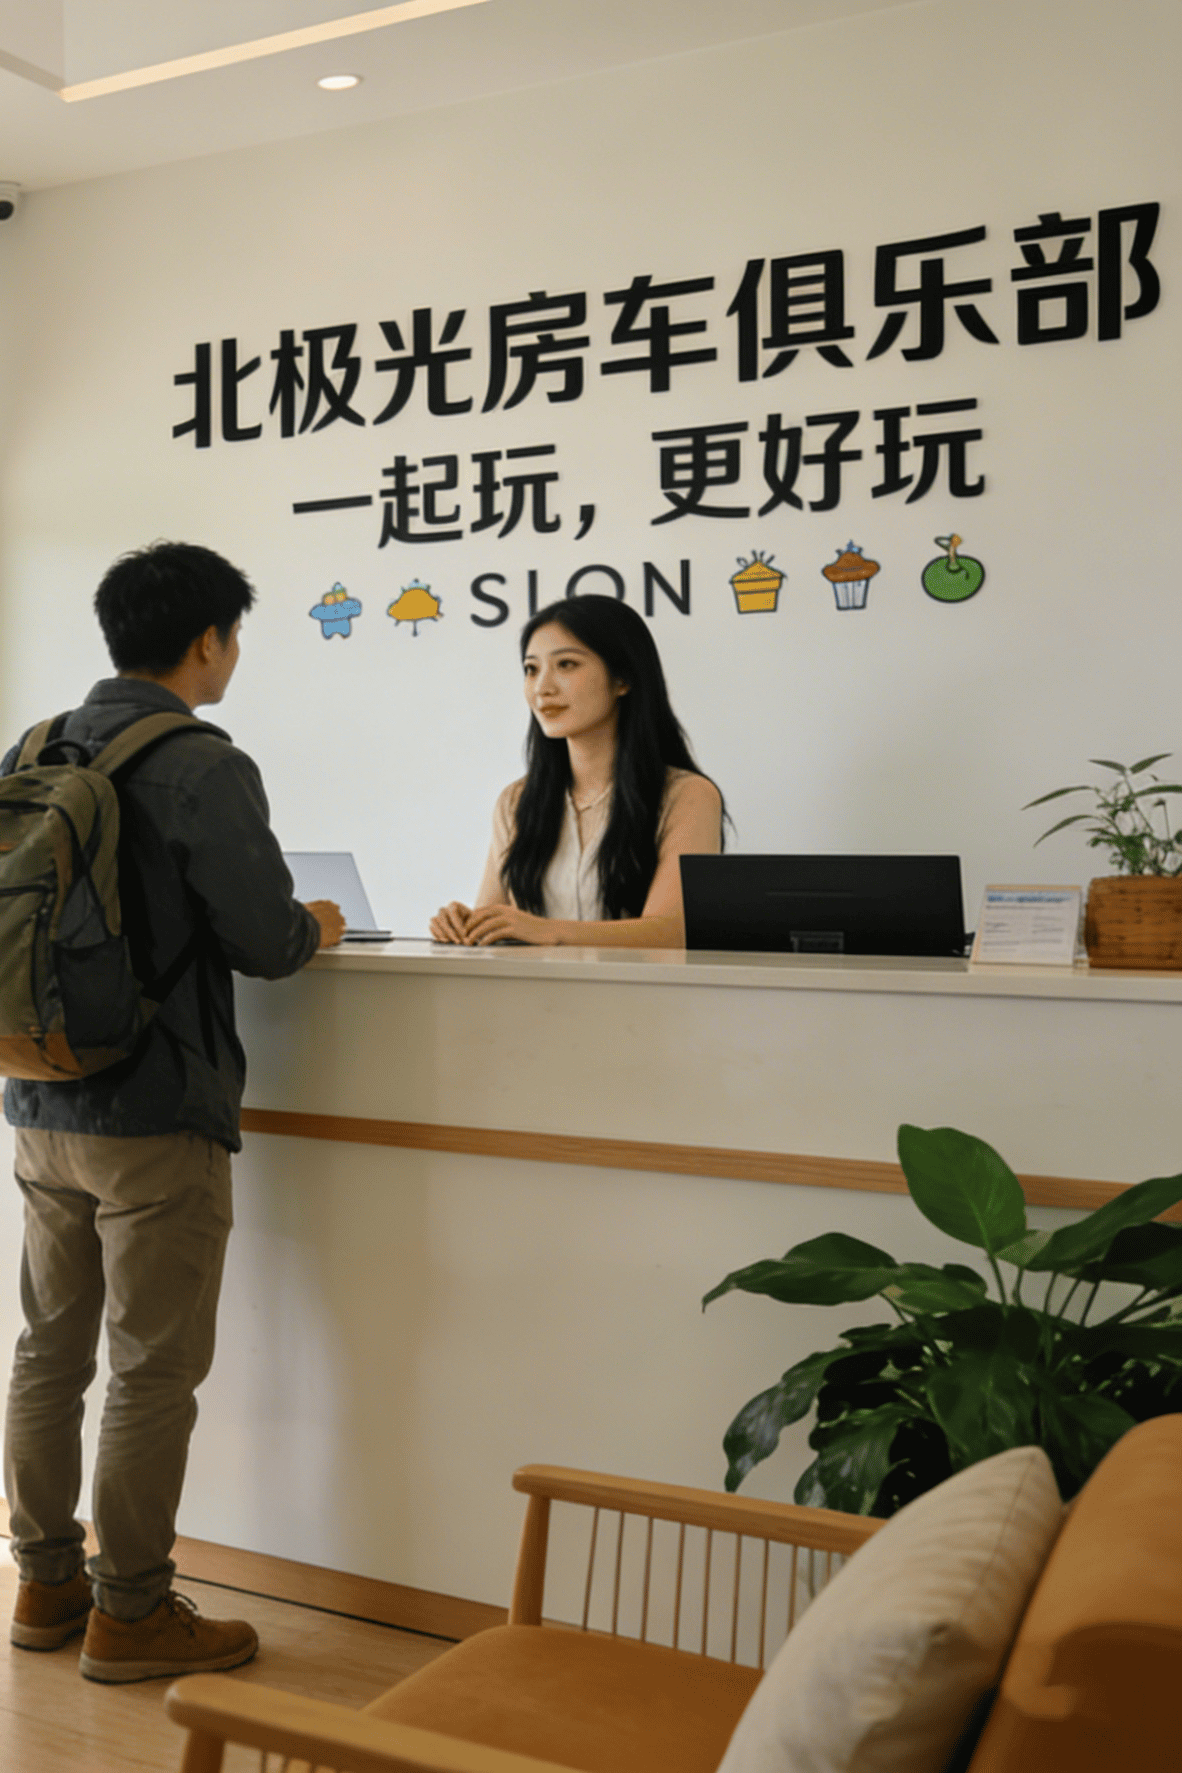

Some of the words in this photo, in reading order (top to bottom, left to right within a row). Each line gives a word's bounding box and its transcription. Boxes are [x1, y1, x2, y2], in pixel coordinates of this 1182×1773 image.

[172, 201, 1162, 450] 北极光房车俱乐部
